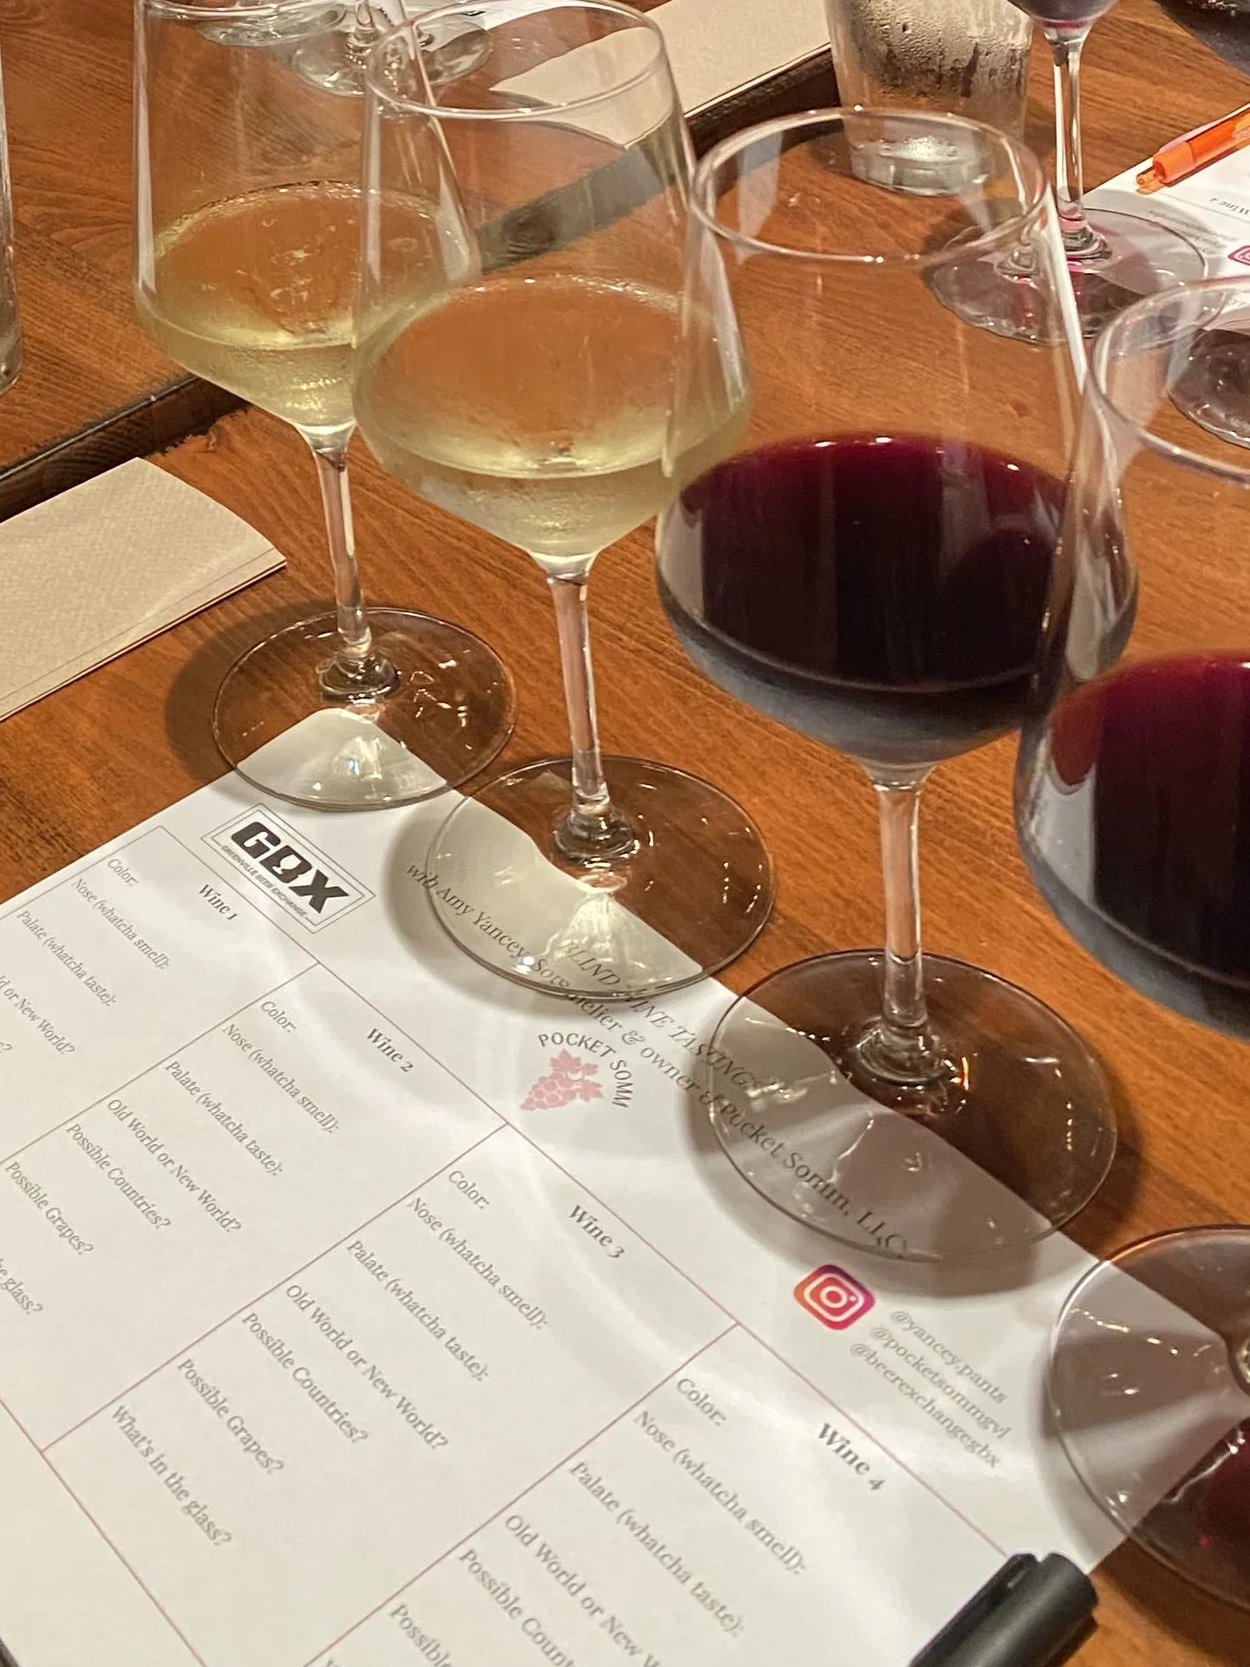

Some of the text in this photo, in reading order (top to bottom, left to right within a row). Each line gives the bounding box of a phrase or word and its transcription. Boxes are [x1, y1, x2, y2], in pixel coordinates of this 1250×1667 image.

[107, 858, 138, 886] Color:
[198, 883, 238, 921] Wine 1
[231, 821, 350, 914] GBX
[15, 910, 115, 1006] Palate (whatcha taste):
[70, 877, 169, 969] Nose (whatcha smell):
[3, 988, 19, 1001] or
[13, 998, 41, 1021] New
[36, 1018, 75, 1054] World?
[260, 1001, 296, 1033] Color:
[366, 1027, 413, 1073] Wine 2
[436, 884, 475, 918] Amy
[621, 1030, 646, 1048] &
[640, 1043, 704, 1093] owner
[718, 1102, 786, 1161] Pocket
[221, 1023, 338, 1134] Nose (whatcha smell):
[537, 1031, 634, 1109] POCKET SOMM
[106, 1099, 241, 1233] Old World or New World?
[163, 1061, 282, 1176] Palate (whatcha taste):
[4, 1161, 94, 1255] Possible Grapes?
[65, 1123, 171, 1229] Possible Countries?
[447, 1170, 489, 1209] Color:
[405, 1197, 547, 1330] Nose (whatcha smell):
[568, 1203, 625, 1258] Wine 3
[0, 1277, 43, 1315] glass?
[346, 1240, 488, 1381] Palate (whatcha taste):
[241, 1312, 368, 1443] Possible Countries?
[285, 1284, 448, 1449] Old World or New World?
[676, 1378, 727, 1426] Color:
[176, 1358, 284, 1474] Possible Grapes?
[818, 1422, 885, 1491] Wine 4
[111, 1405, 231, 1546] What's in the glass?
[632, 1410, 805, 1575] Nose (whatcha smell):
[459, 1549, 524, 1620] Possible
[504, 1514, 643, 1659] Old World or New
[568, 1461, 741, 1637] Palate (whatcha taste):
